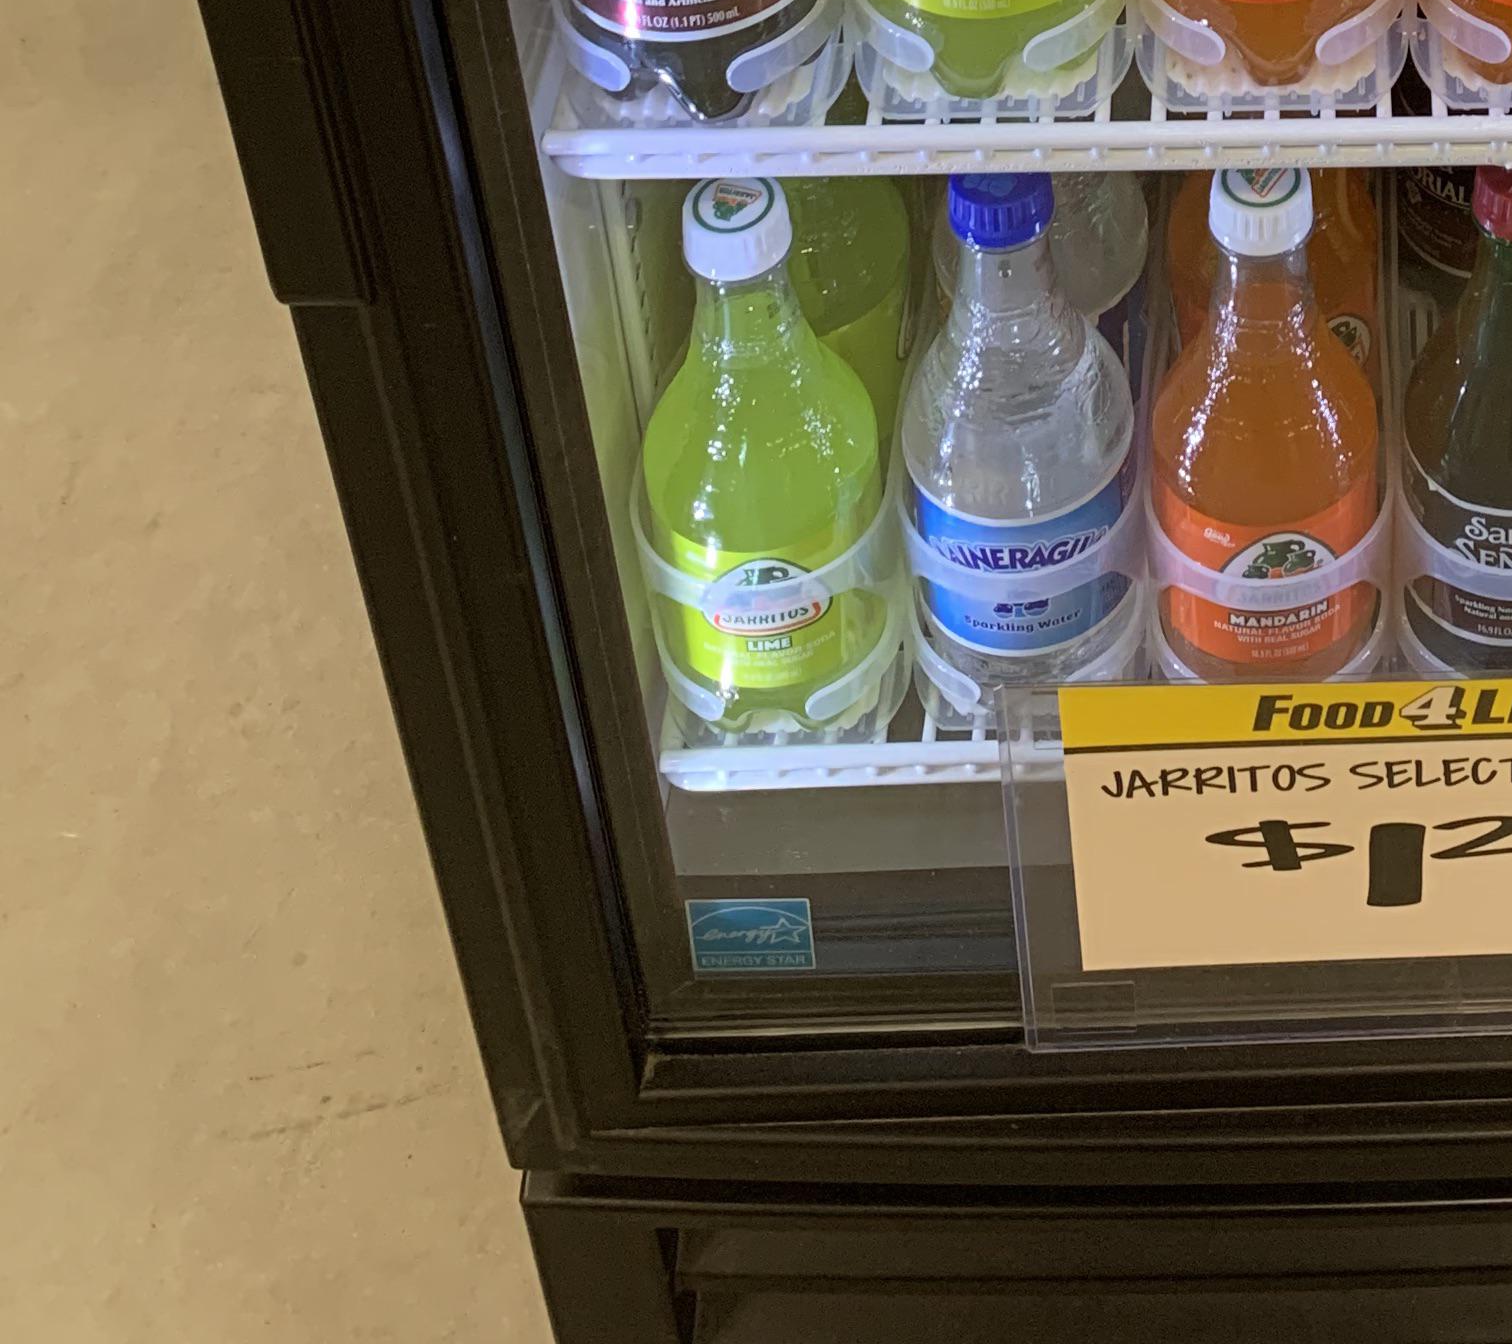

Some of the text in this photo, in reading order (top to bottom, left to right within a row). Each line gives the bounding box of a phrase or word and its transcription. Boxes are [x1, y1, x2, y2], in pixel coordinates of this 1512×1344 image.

[654, 15, 668, 28] OZ
[707, 12, 725, 25] 500
[964, 609, 1081, 633] Sparkling Water
[1228, 599, 1329, 628] MANDARIN
[1214, 620, 1264, 635] NATURAL
[746, 636, 793, 652] LIME
[1237, 633, 1263, 644] WITH
[1265, 634, 1288, 644] REAL
[1101, 761, 1332, 800] JARRITOS
[702, 955, 806, 967] ENERGY STAR
